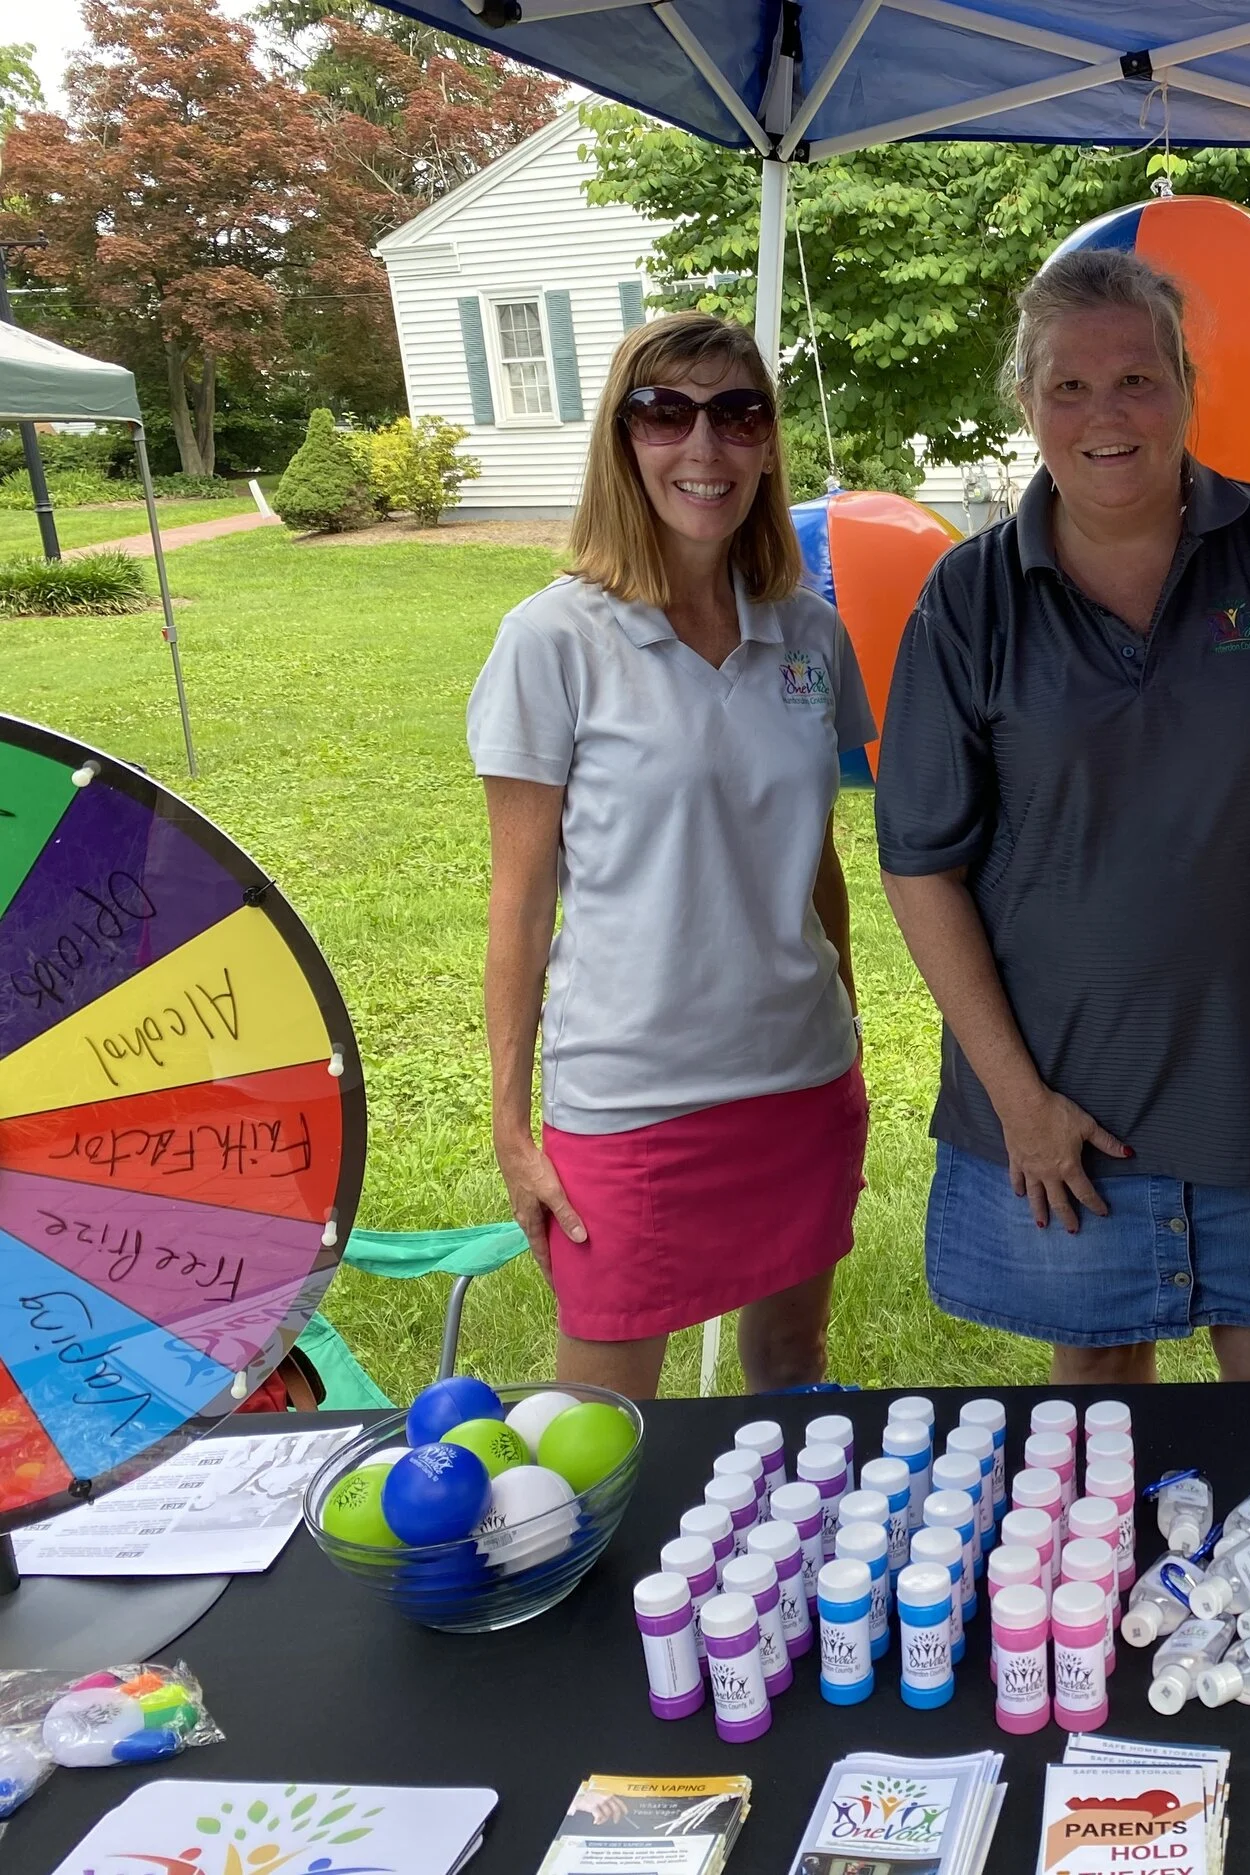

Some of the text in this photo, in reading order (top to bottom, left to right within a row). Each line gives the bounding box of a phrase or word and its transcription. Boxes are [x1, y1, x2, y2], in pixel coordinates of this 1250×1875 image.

[11, 871, 156, 1009] Opioids
[85, 968, 238, 1086] Alcohol
[48, 1112, 312, 1178] Faith Factor
[37, 1209, 244, 1303] Free Prize
[18, 1291, 152, 1437] Vaping
[1090, 1755, 1115, 1763] SAFE
[1102, 1741, 1208, 1758] SAFE HOME STORAGE
[626, 1784, 706, 1792] TEEN VAPING
[831, 1822, 943, 1843] OneVoice
[1065, 1820, 1188, 1838] PARENTS
[1111, 1844, 1188, 1862] HOLD
